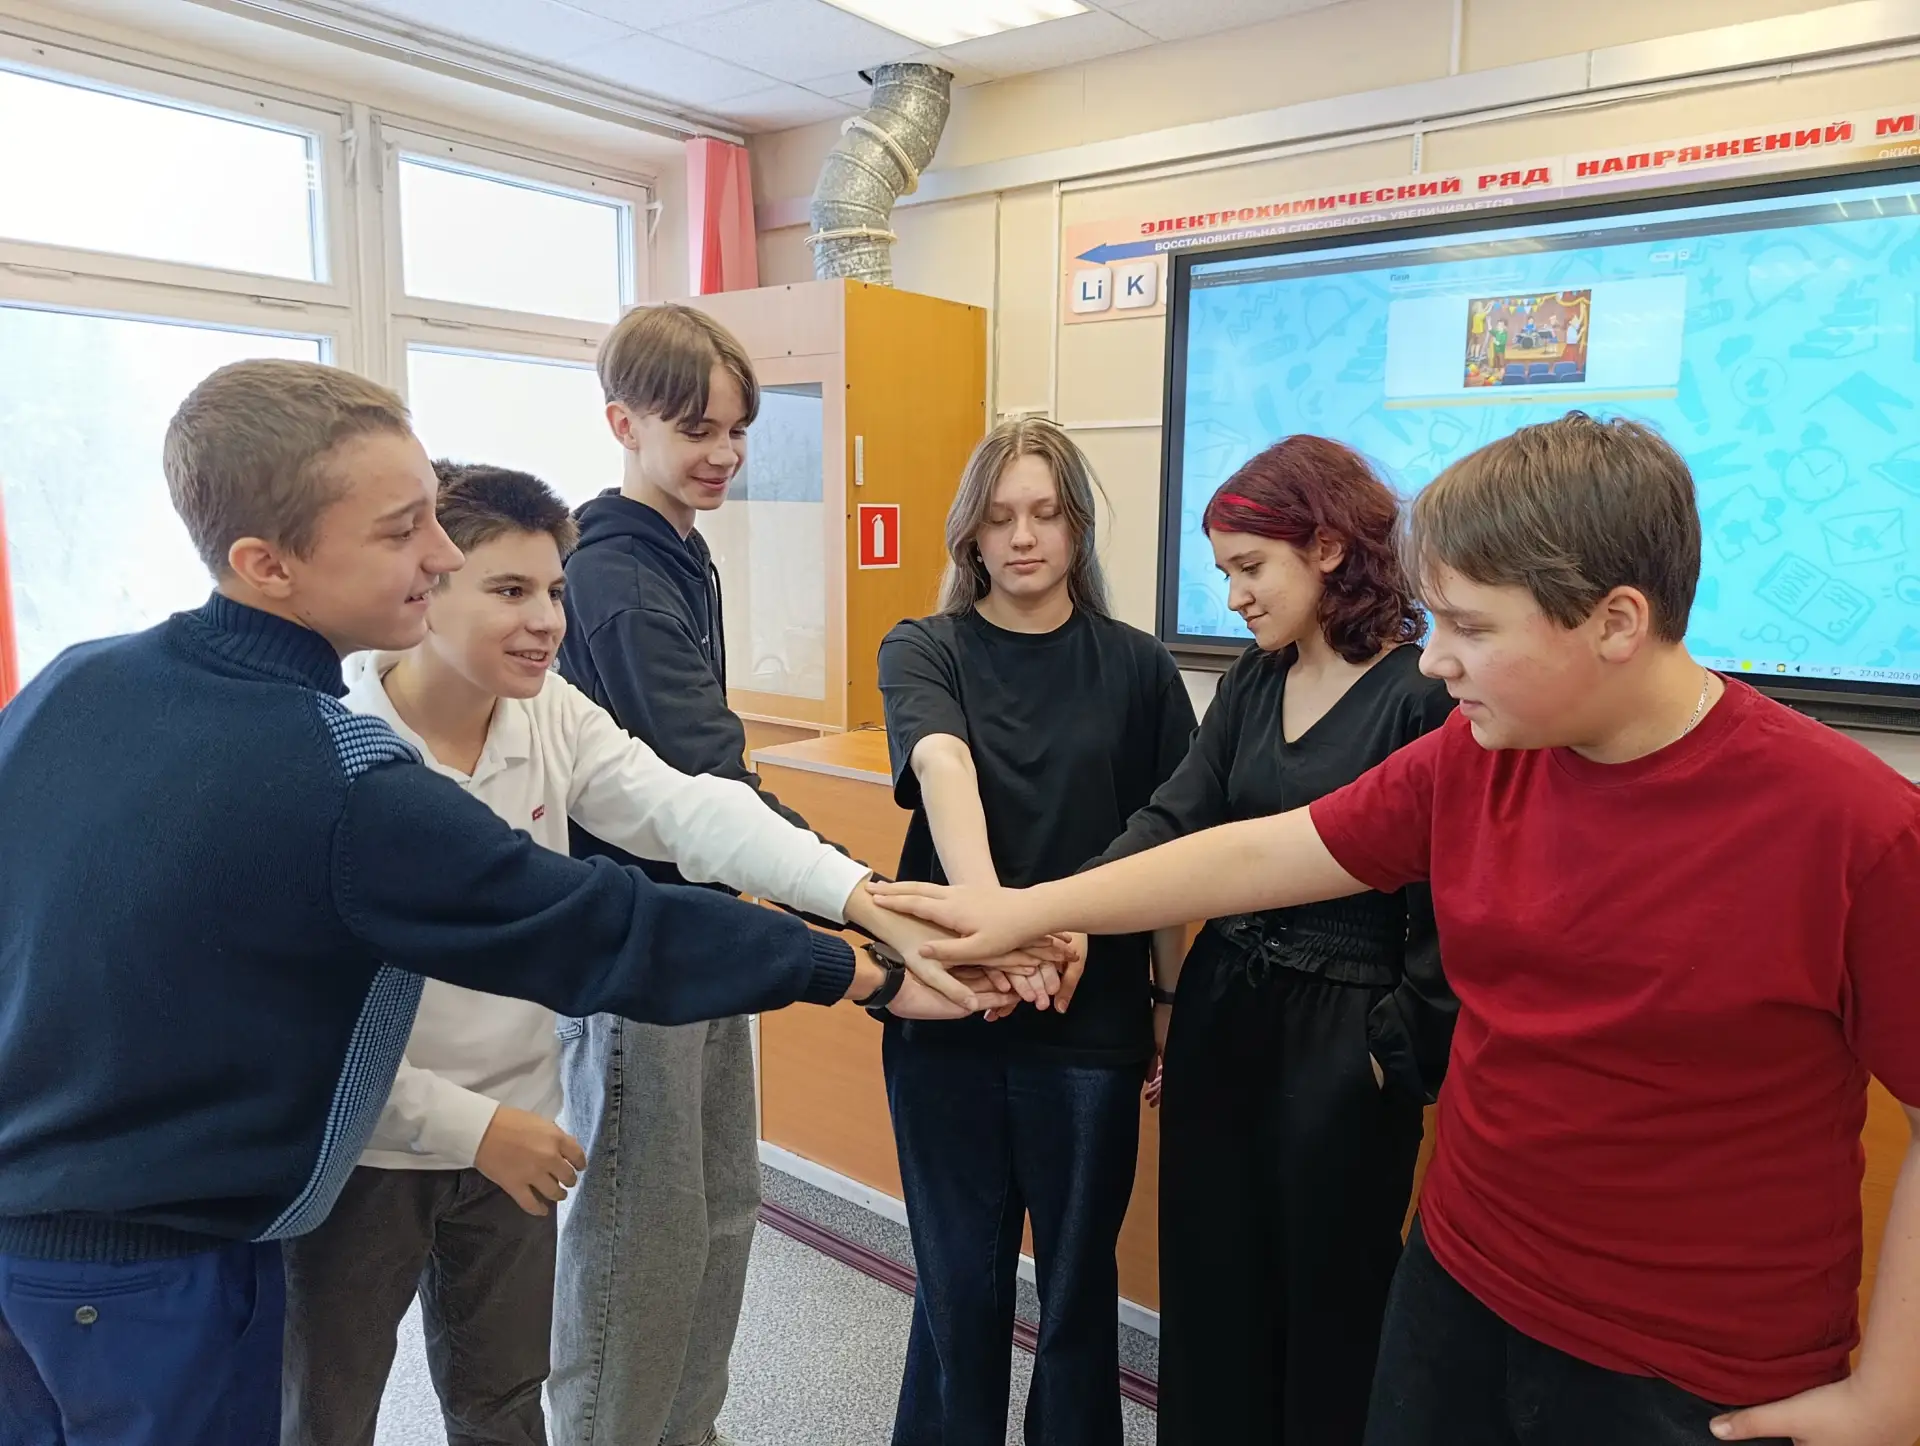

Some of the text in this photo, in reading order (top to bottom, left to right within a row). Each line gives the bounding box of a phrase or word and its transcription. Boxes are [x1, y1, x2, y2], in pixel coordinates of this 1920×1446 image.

[1879, 145, 1920, 158] ОКИС
[1141, 114, 1920, 234] ЭЛЕКТРОХИМИЧЕСКИЙ РЯД НАПРЯЖЕНИЙ М
[1155, 198, 1513, 251] ВОССТАНОВИТЕЛЬНАЯ СПОСОБНОСТЬ УВЕЛИЧИВАЕТСЯ
[1082, 280, 1103, 301] Li
[1127, 275, 1145, 296] K
[1859, 669, 1911, 681] 27.04.2026
